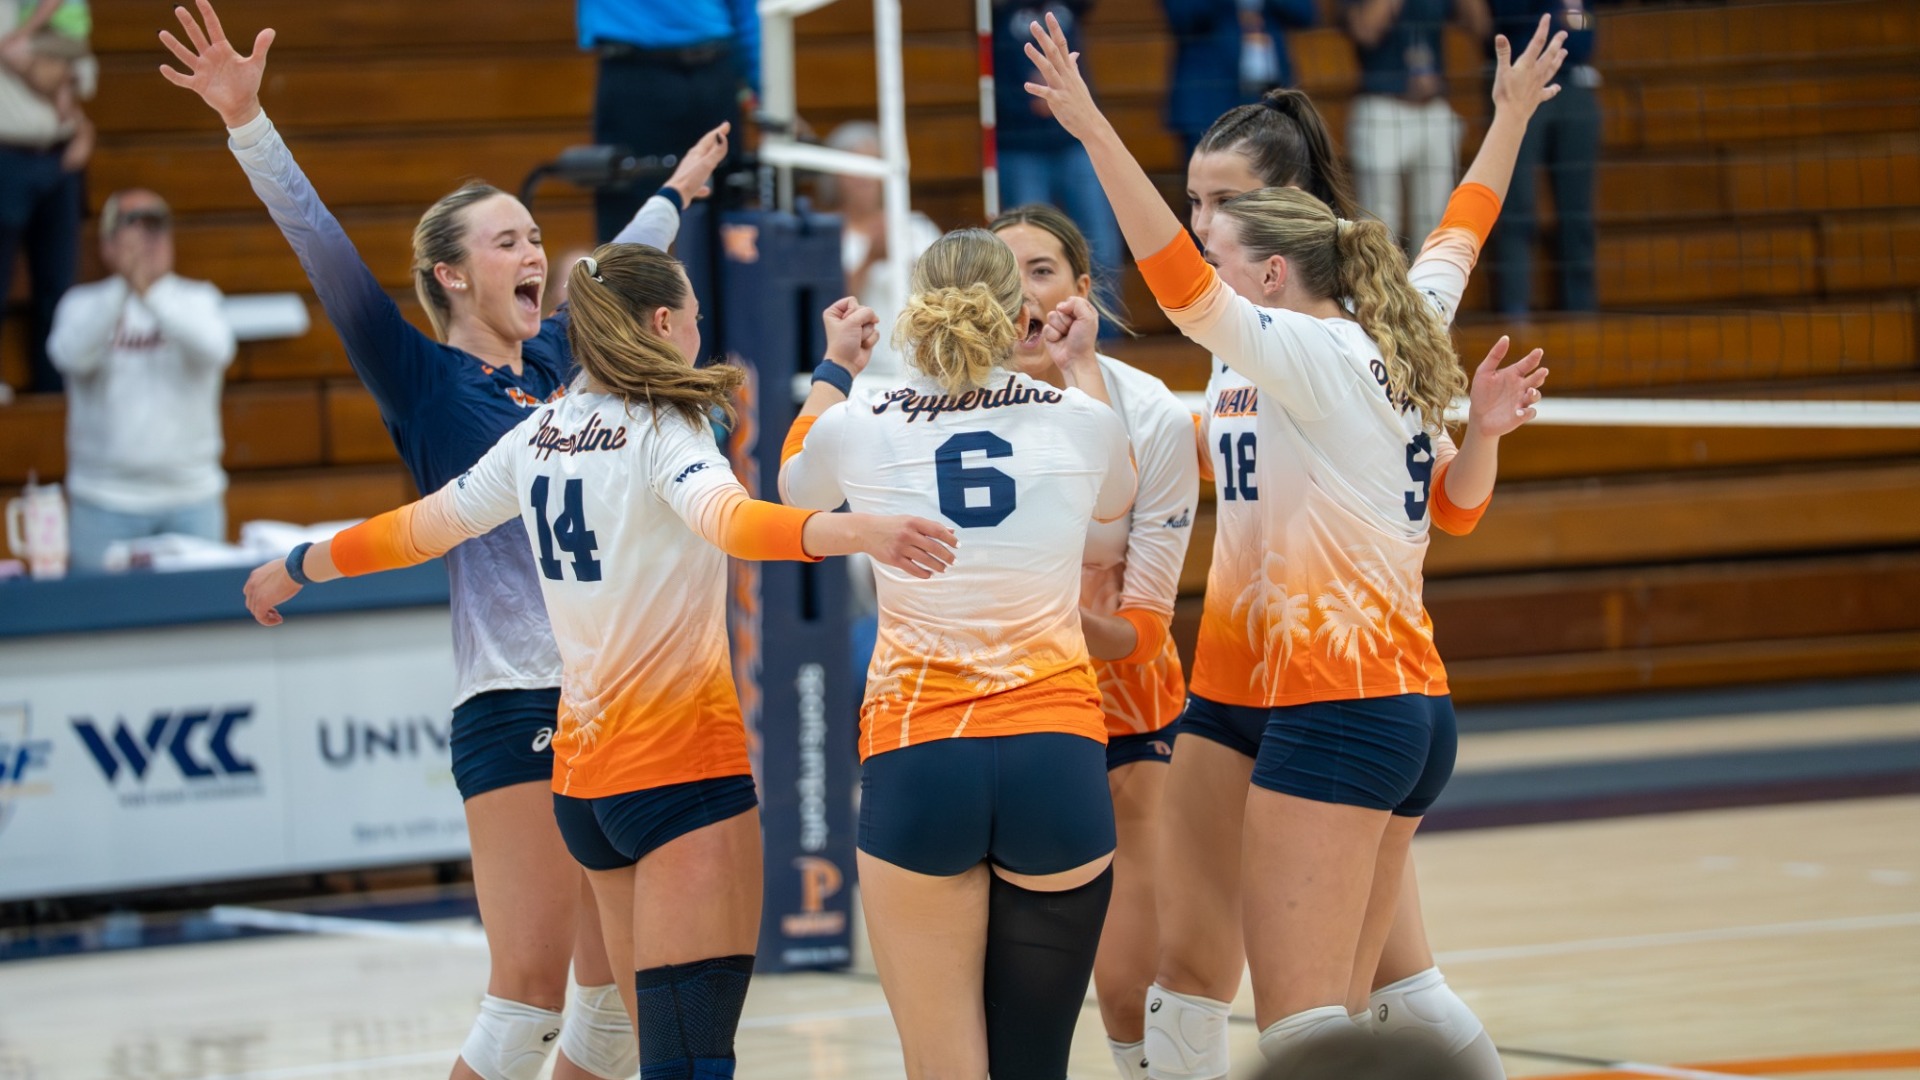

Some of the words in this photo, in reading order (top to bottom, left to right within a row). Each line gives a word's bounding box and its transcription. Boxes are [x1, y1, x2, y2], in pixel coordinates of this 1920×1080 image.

[528, 408, 627, 461] Pepdine
[675, 462, 710, 483] WCC
[1219, 432, 1259, 500] 18
[935, 430, 1017, 528] 6
[1404, 432, 1434, 521] 9
[530, 475, 602, 582] 14
[69, 703, 259, 786] WCC
